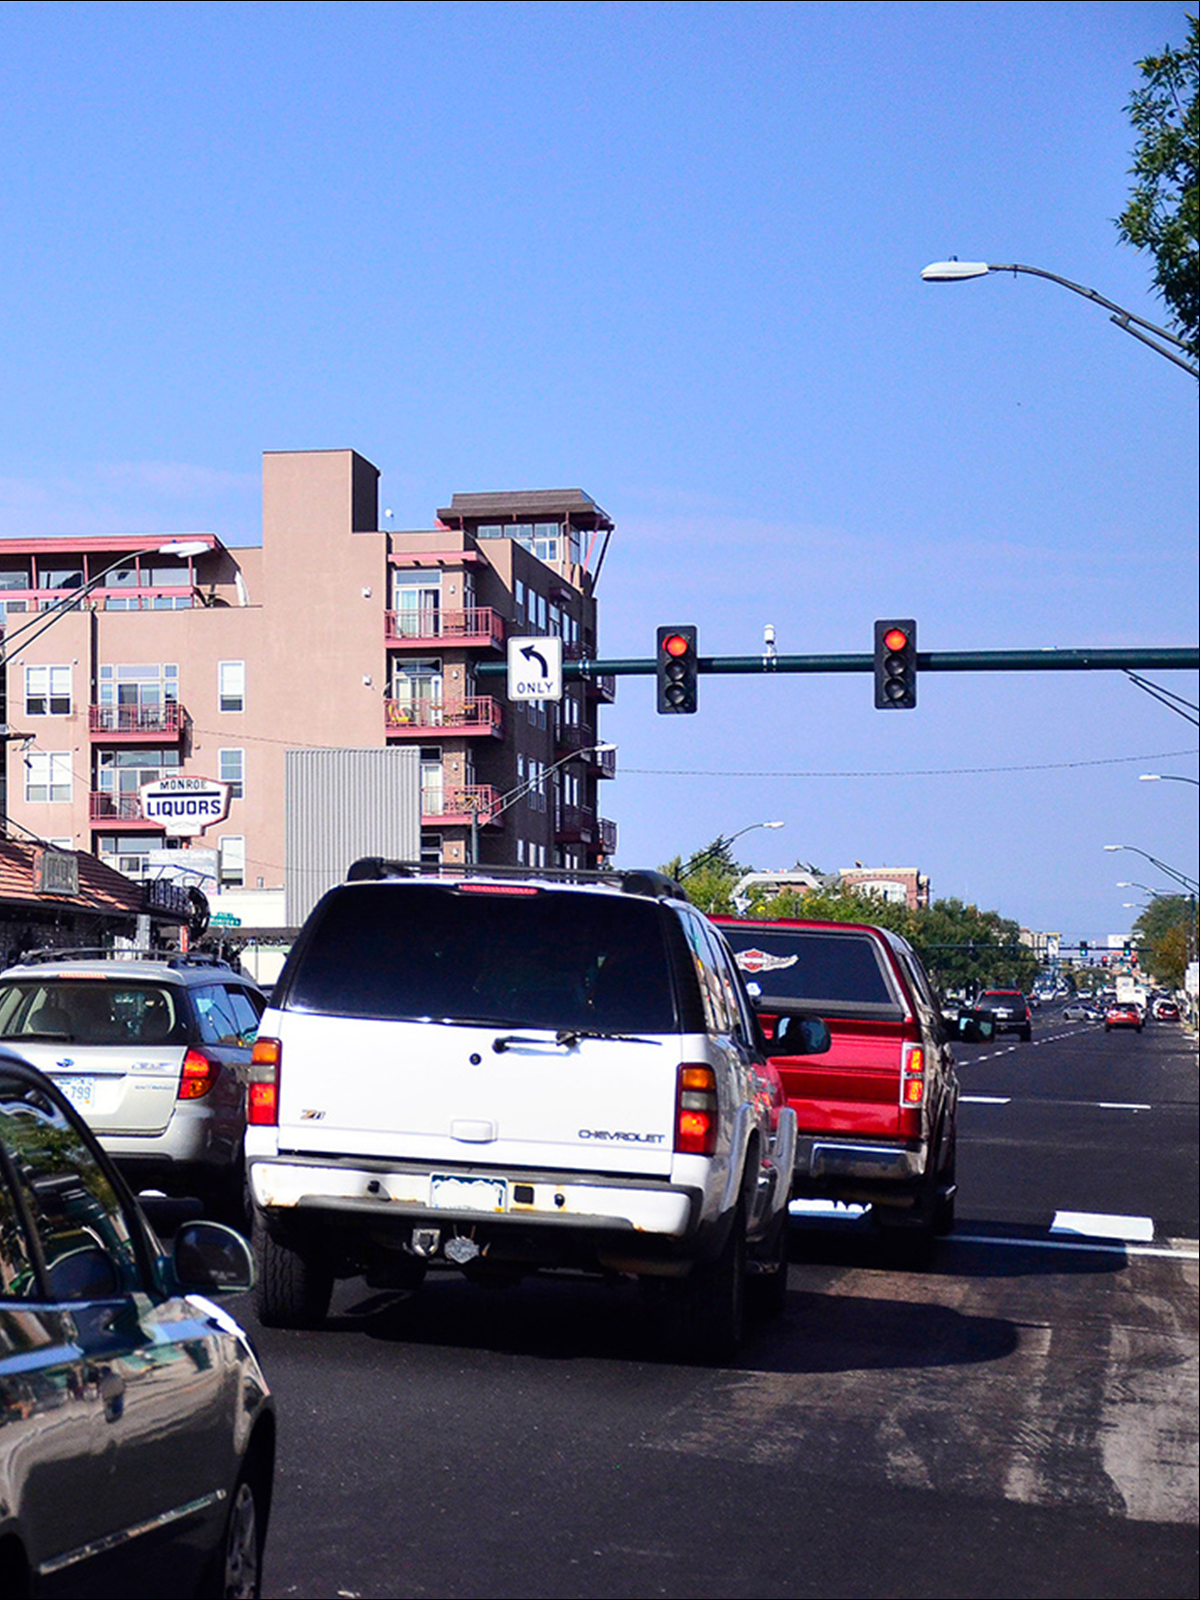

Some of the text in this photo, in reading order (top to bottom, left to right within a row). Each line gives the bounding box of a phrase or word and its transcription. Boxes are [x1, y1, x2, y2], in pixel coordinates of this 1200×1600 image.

[517, 682, 553, 695] ONLY
[160, 779, 208, 791] MONROE
[147, 800, 221, 817] LIQUORS
[578, 1129, 665, 1143] CHEVROLET
